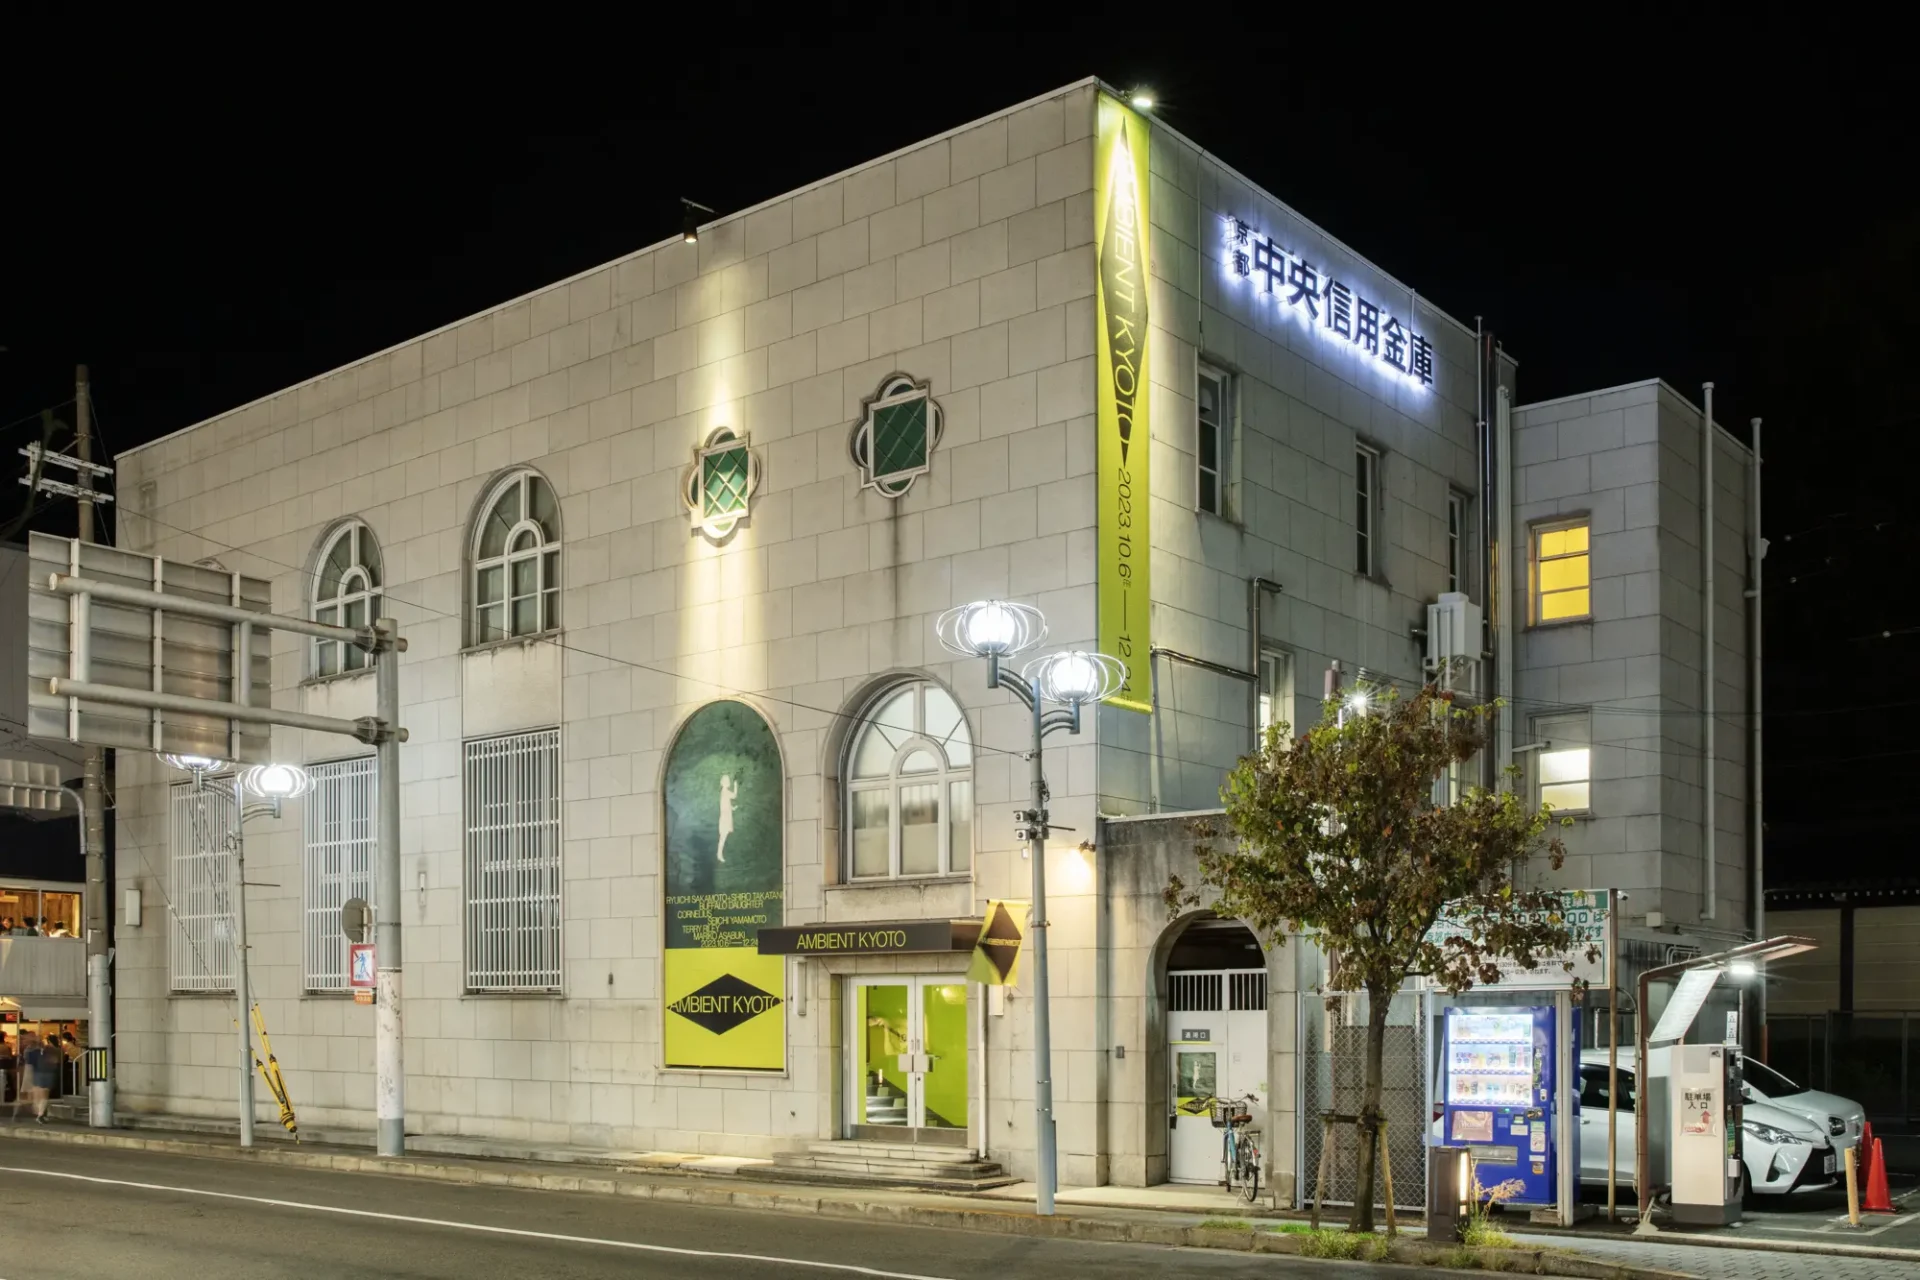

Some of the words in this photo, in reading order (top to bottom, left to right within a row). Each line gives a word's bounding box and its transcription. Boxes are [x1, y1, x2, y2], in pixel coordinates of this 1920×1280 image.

[1233, 218, 1250, 277] 京都
[1252, 237, 1433, 385] 中央信用金庫
[1114, 315, 1135, 443] KYOTO
[796, 931, 856, 949] AMBIENT
[858, 930, 906, 948] KYOTO
[670, 995, 731, 1013] AMBIENT
[1684, 1092, 1711, 1102] 駐車場
[1687, 1101, 1708, 1110] 入口
